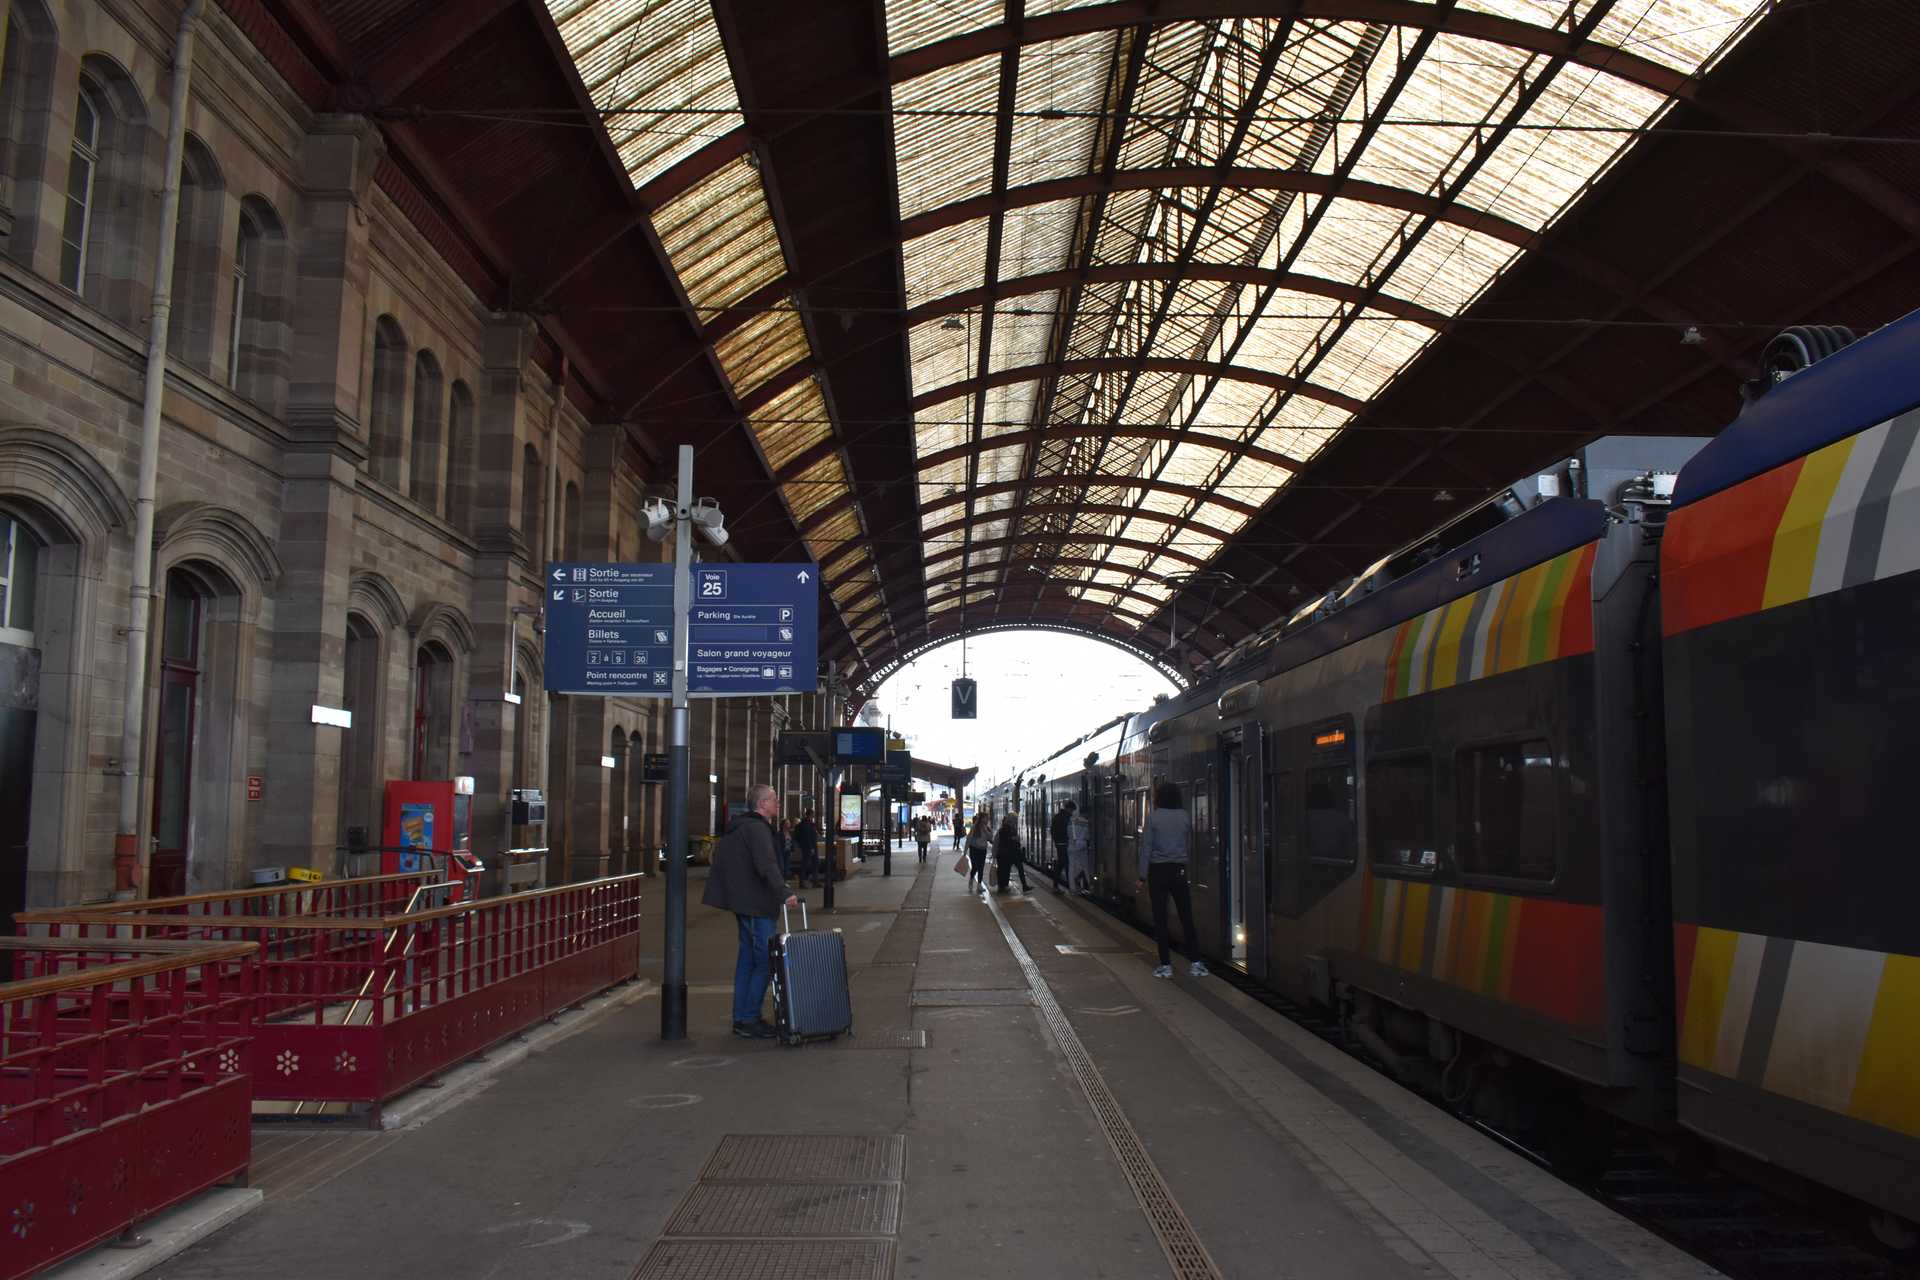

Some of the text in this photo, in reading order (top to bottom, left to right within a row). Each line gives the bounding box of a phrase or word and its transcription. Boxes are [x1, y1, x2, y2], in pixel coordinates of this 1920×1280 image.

[589, 568, 620, 578] Sortie
[589, 588, 619, 598] Sortie
[702, 582, 722, 596] 25
[588, 609, 626, 619] Accueil
[697, 611, 731, 621] Parking
[782, 610, 791, 620] P
[588, 629, 620, 639] Billets
[615, 655, 622, 663] 9
[696, 649, 792, 659] Salon grand voyageur
[586, 672, 607, 680] Point
